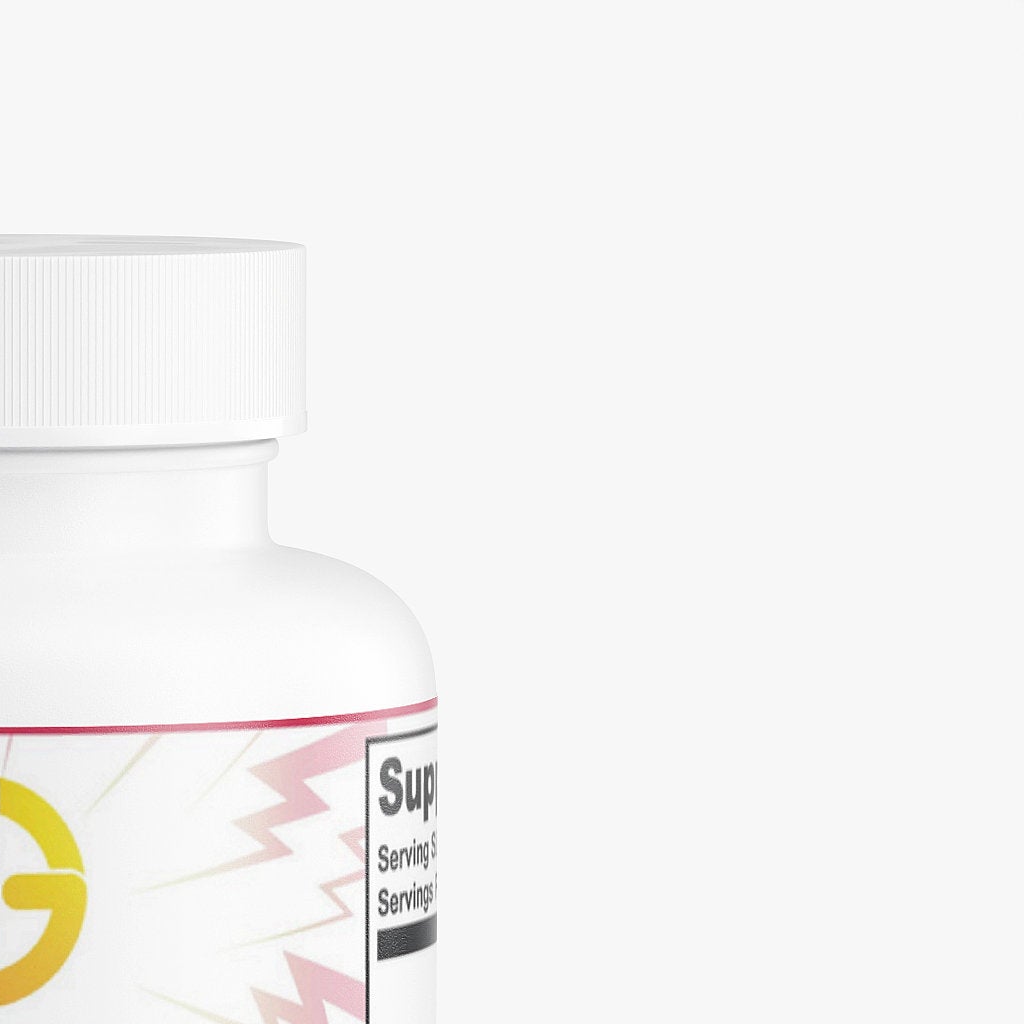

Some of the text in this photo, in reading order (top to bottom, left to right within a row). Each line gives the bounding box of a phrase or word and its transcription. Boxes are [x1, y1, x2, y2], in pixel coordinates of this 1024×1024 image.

[378, 756, 437, 823] Sup
[378, 838, 429, 873] Serving
[378, 882, 434, 917] Servings
